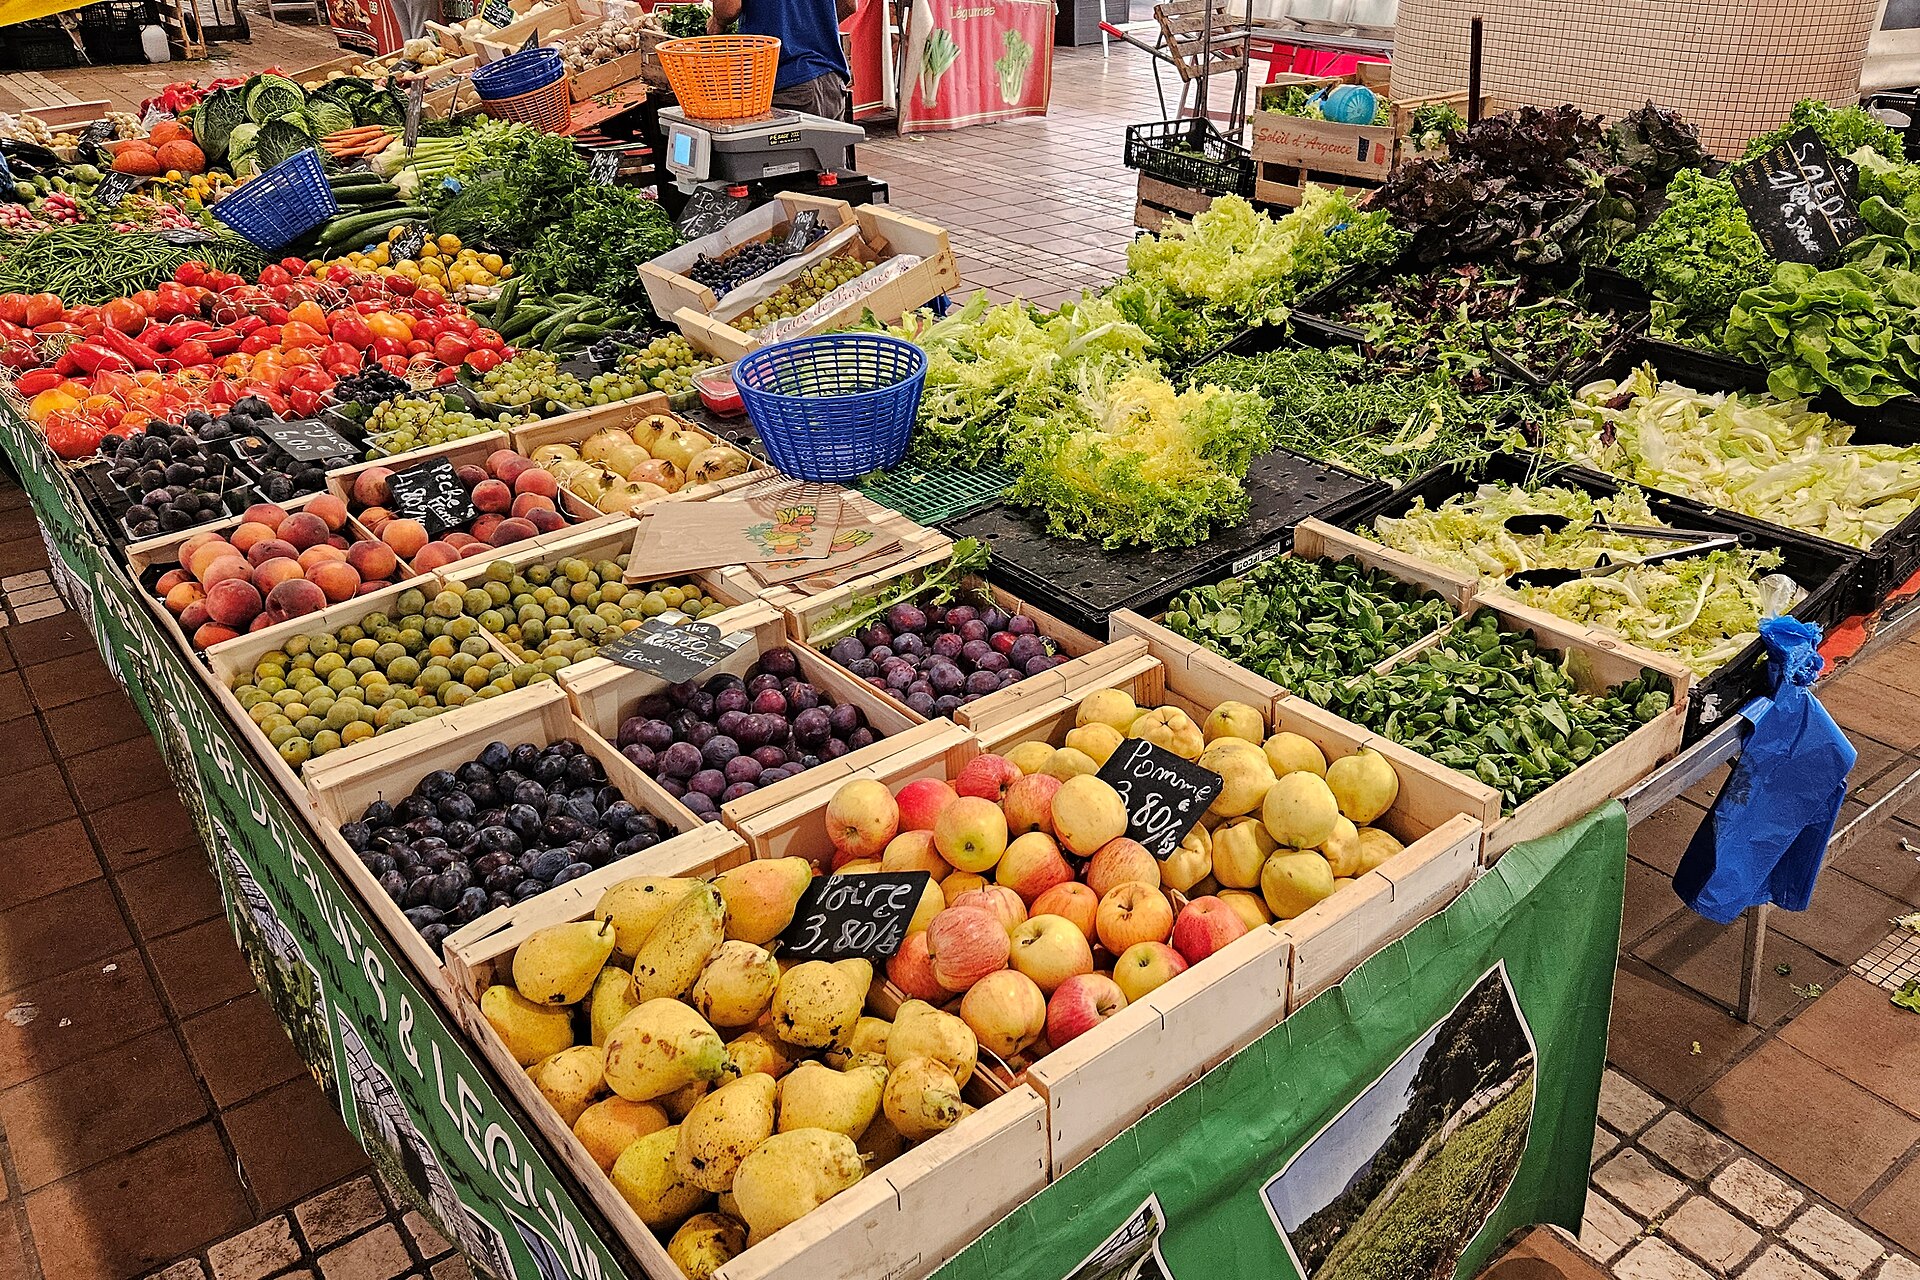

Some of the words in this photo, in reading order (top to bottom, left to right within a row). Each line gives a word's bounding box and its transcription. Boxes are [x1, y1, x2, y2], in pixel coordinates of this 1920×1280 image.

[950, 5, 996, 21] Légumes
[1257, 127, 1289, 145] Soleil
[1292, 133, 1353, 155] d'Argence
[813, 300, 829, 320] de
[831, 270, 894, 305] Provence
[1124, 740, 1213, 803] Pomme
[816, 874, 913, 911] Poire
[398, 993, 425, 1080] &
[432, 1040, 610, 1280] LEGUM
